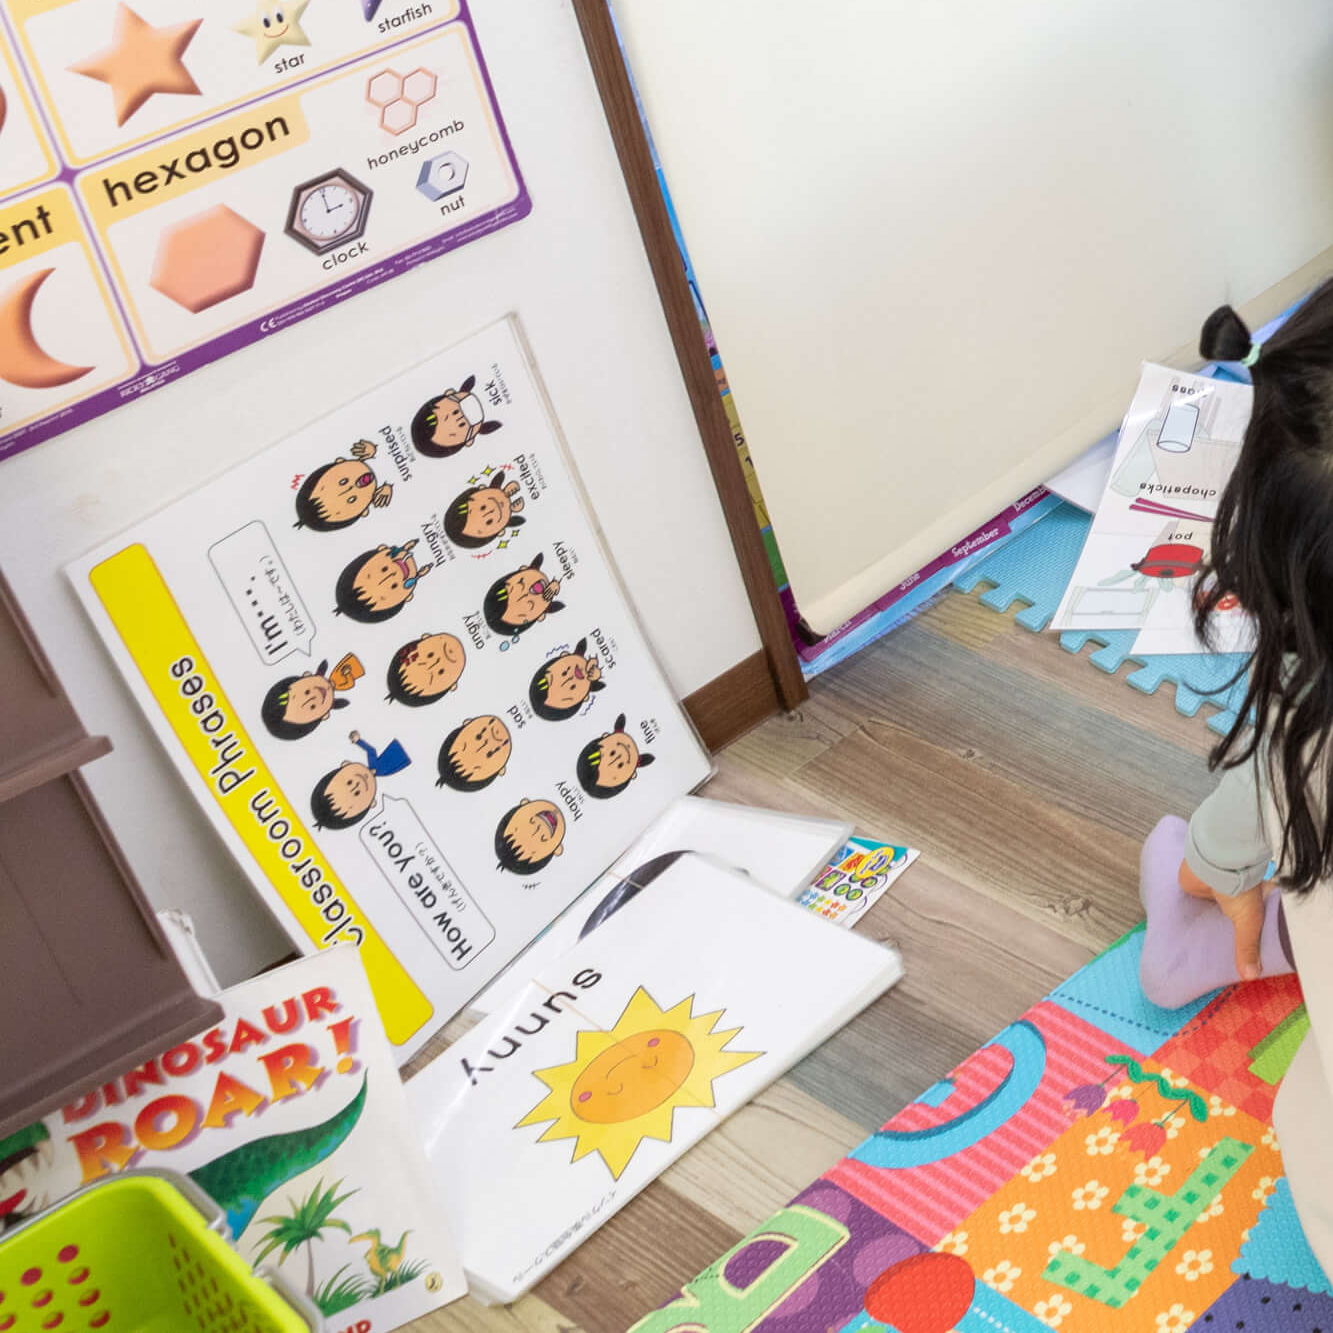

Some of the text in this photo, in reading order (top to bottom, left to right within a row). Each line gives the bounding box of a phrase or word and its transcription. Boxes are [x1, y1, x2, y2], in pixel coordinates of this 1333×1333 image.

[377, 2, 433, 34] starfish
[274, 53, 306, 75] star
[102, 115, 291, 208] hexagon
[367, 119, 466, 171] honeycomb
[439, 195, 466, 217] nut
[321, 240, 370, 272] clock
[484, 379, 503, 407] sick
[1171, 383, 1208, 398] ass
[379, 424, 413, 483] surprised
[513, 454, 541, 501] excited
[1139, 481, 1217, 498] chopsticks
[951, 527, 1000, 556] September
[1013, 485, 1048, 513] Decemb
[1169, 531, 1194, 541] pot
[421, 521, 447, 569] hungry
[552, 540, 576, 581] sleepy
[463, 613, 485, 650] angry
[590, 627, 617, 670] scared
[170, 654, 253, 797] Phrases
[506, 704, 527, 729] sad
[640, 719, 657, 745] fine
[555, 780, 584, 822] happy
[368, 820, 474, 963] How are you?
[460, 968, 602, 1086] sunny
[67, 1016, 356, 1185] ROAR!
